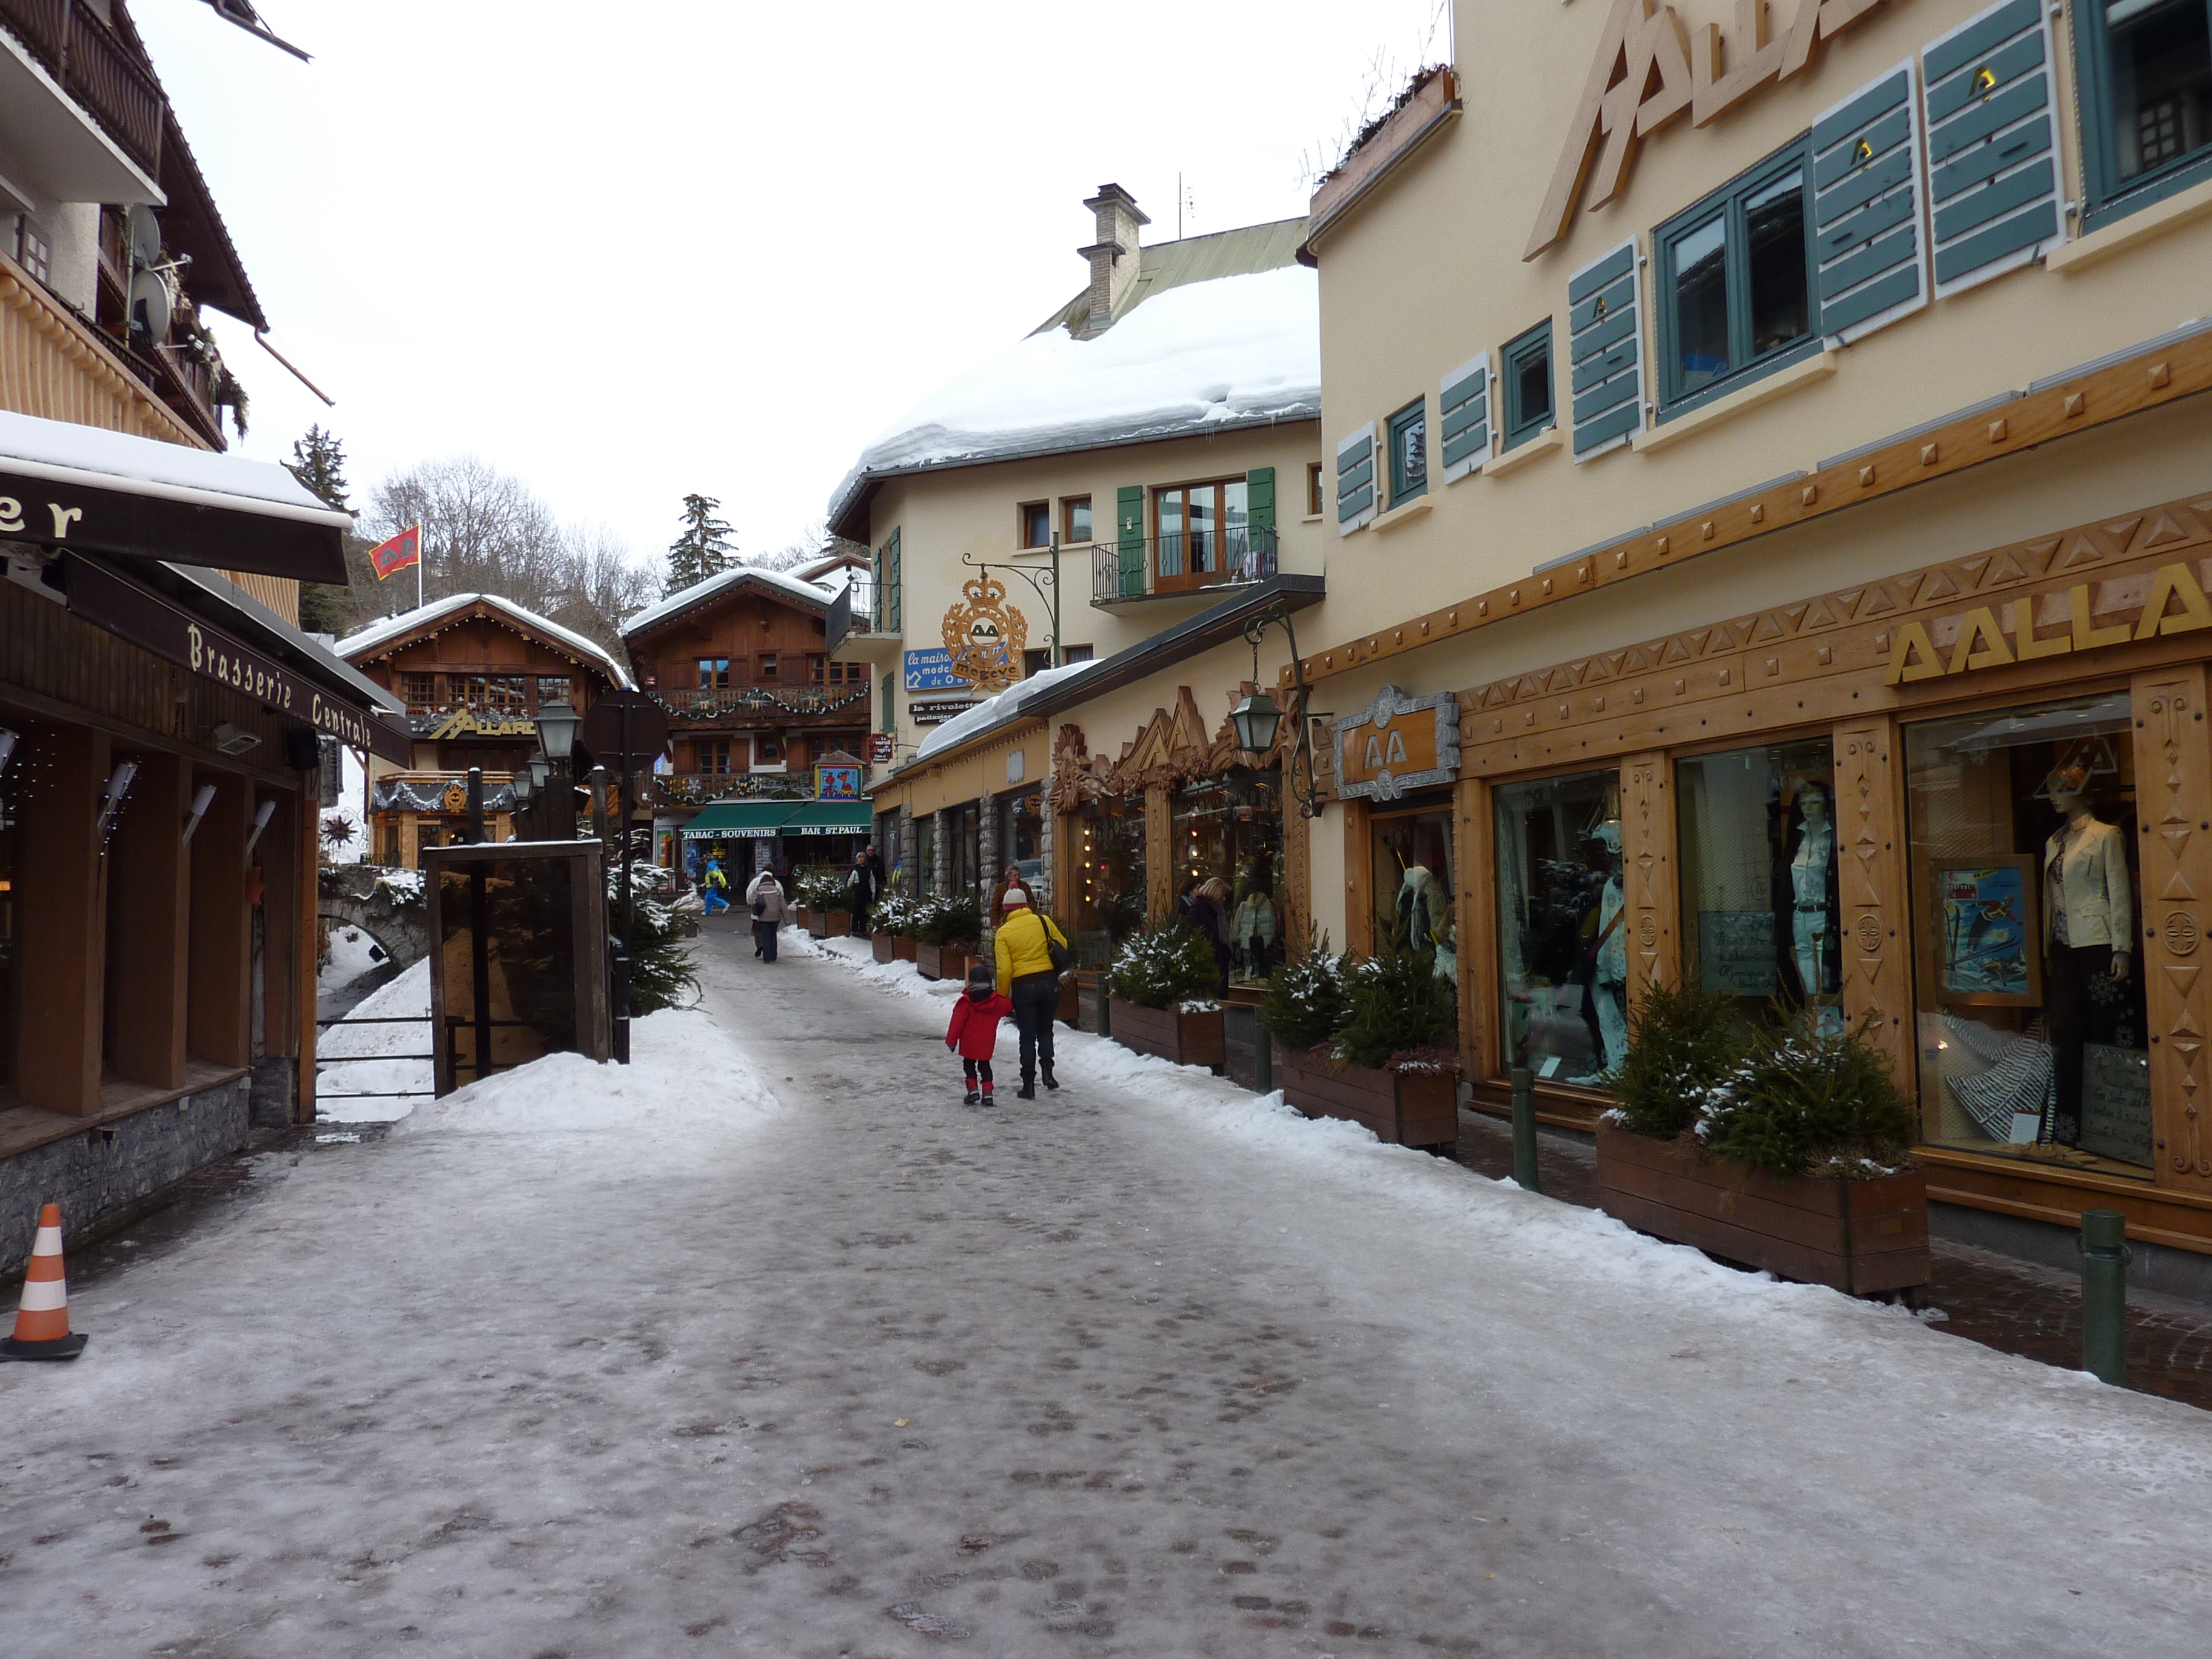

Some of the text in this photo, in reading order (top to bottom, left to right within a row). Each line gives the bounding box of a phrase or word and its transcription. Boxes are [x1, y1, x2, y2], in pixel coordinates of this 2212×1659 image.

[908, 652, 919, 666] la
[188, 623, 371, 747] Brasserie Centrale
[1363, 729, 1407, 769] AA
[683, 830, 714, 839] TABAC
[720, 829, 776, 838] SOUVENIRS
